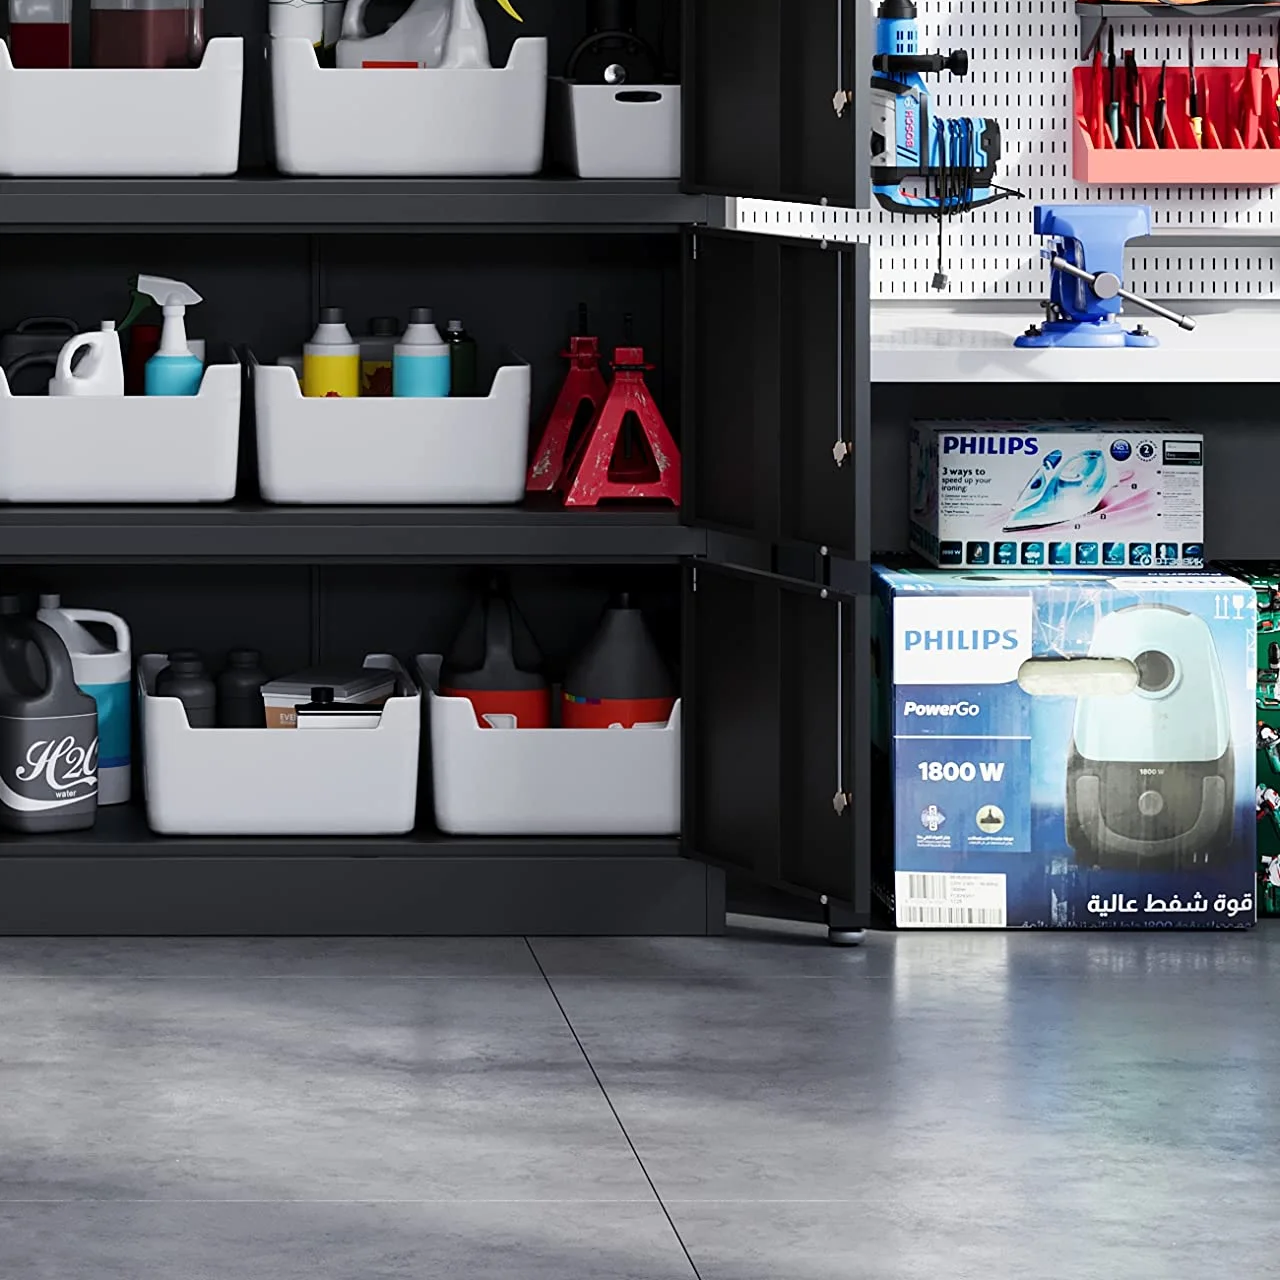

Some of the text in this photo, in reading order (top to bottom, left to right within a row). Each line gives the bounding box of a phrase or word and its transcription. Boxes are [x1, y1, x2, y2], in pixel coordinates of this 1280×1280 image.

[905, 110, 914, 148] BOSCH
[943, 436, 1039, 456] PHILIPS
[1144, 445, 1150, 454] 2
[942, 466, 986, 477] 3 ways to
[942, 477, 963, 485] speed
[904, 629, 1019, 651] PHILIPS
[904, 701, 980, 716] PowerGo
[918, 761, 1005, 782] 1800 W
[1139, 768, 1157, 776] 1800
[55, 790, 77, 799] water
[1087, 891, 1253, 917] قوة شفط عالية
